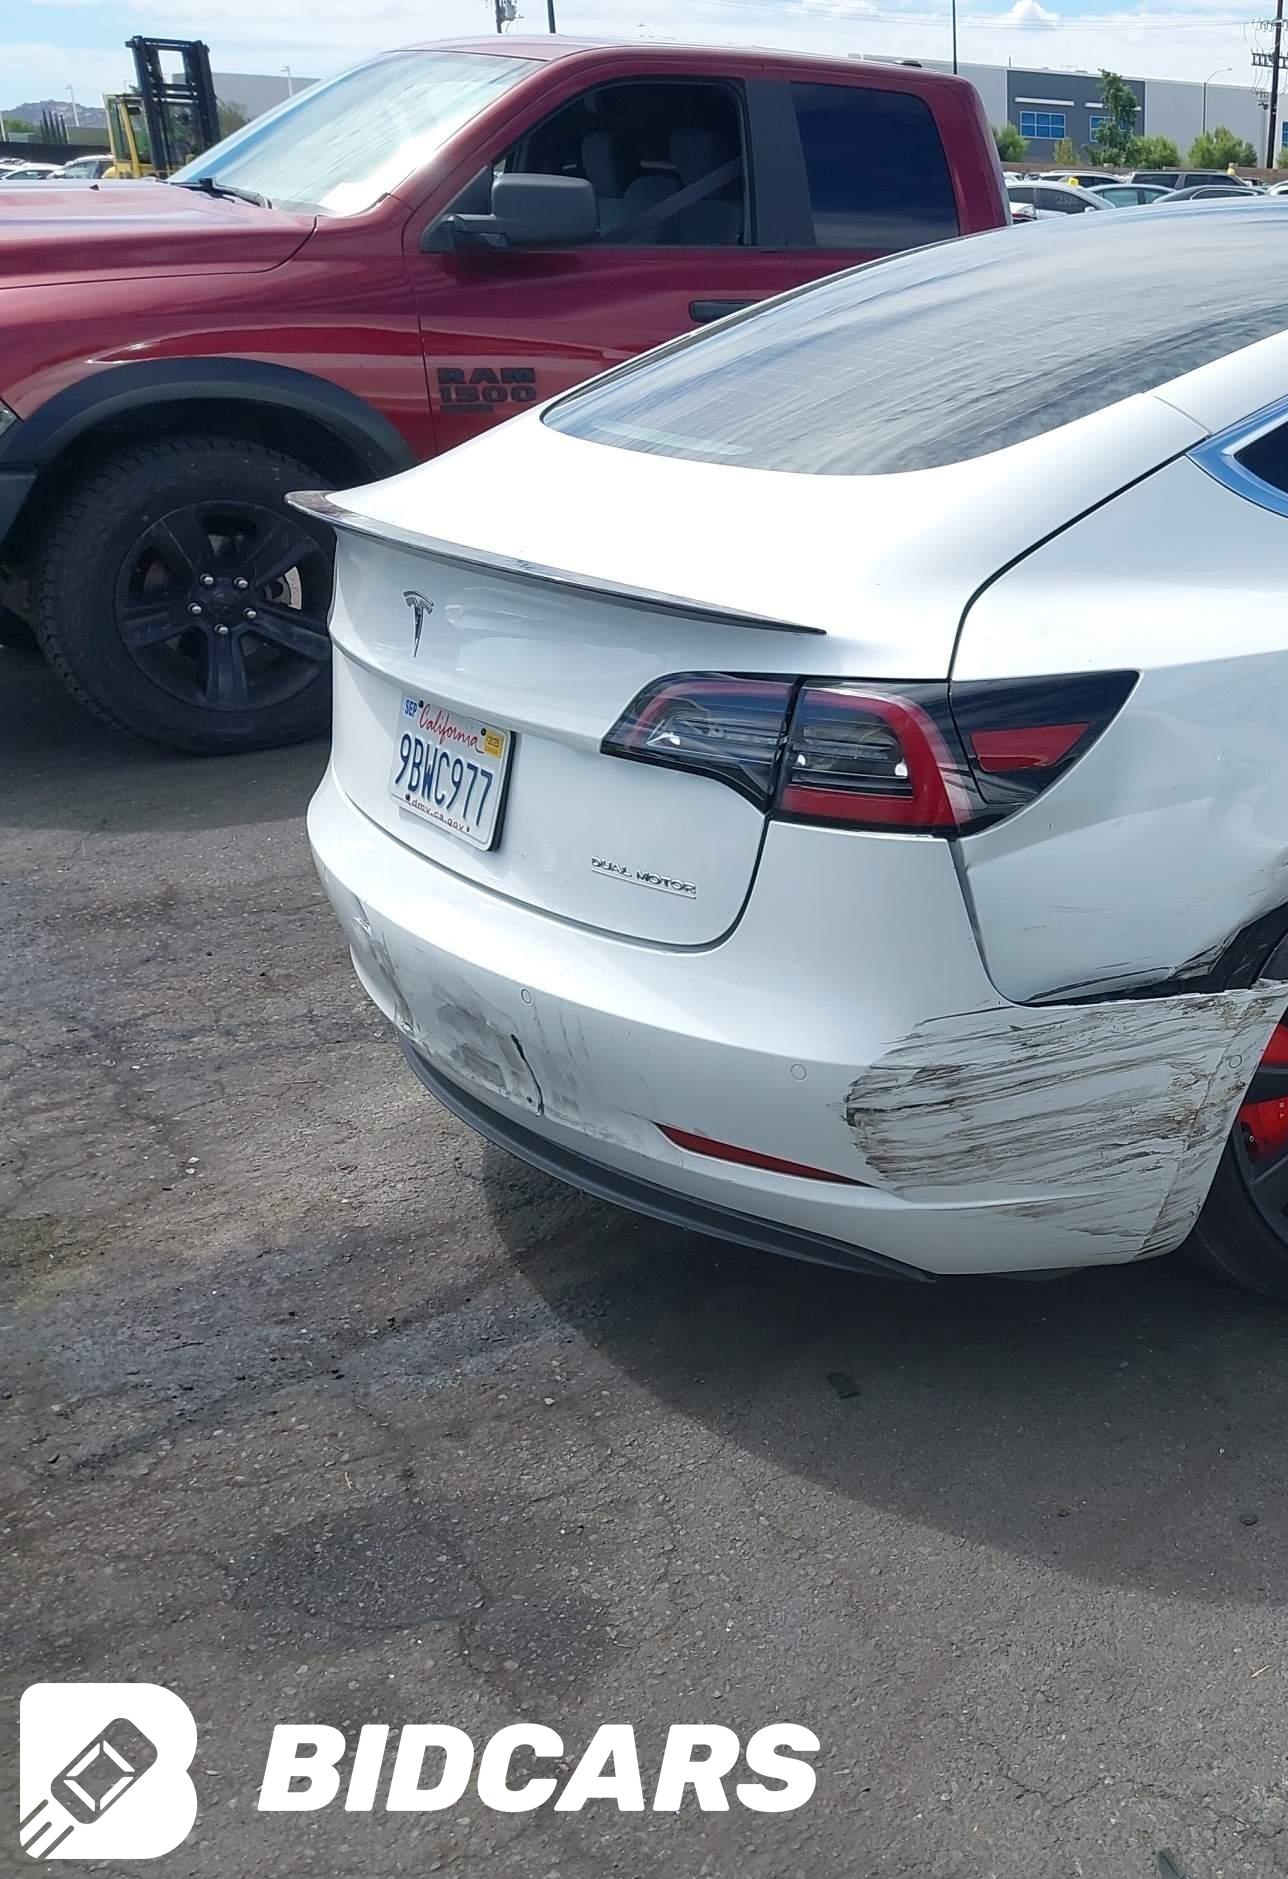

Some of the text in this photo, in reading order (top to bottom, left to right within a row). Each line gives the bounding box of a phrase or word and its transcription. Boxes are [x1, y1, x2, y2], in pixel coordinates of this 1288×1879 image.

[437, 367, 536, 384] RAM
[439, 385, 536, 402] 1500
[405, 699, 418, 717] SEP
[419, 703, 485, 754] California
[394, 733, 494, 827] 9BWC977
[411, 798, 465, 833] dmv.ca.gov
[591, 855, 697, 895] DUAL MOTOR
